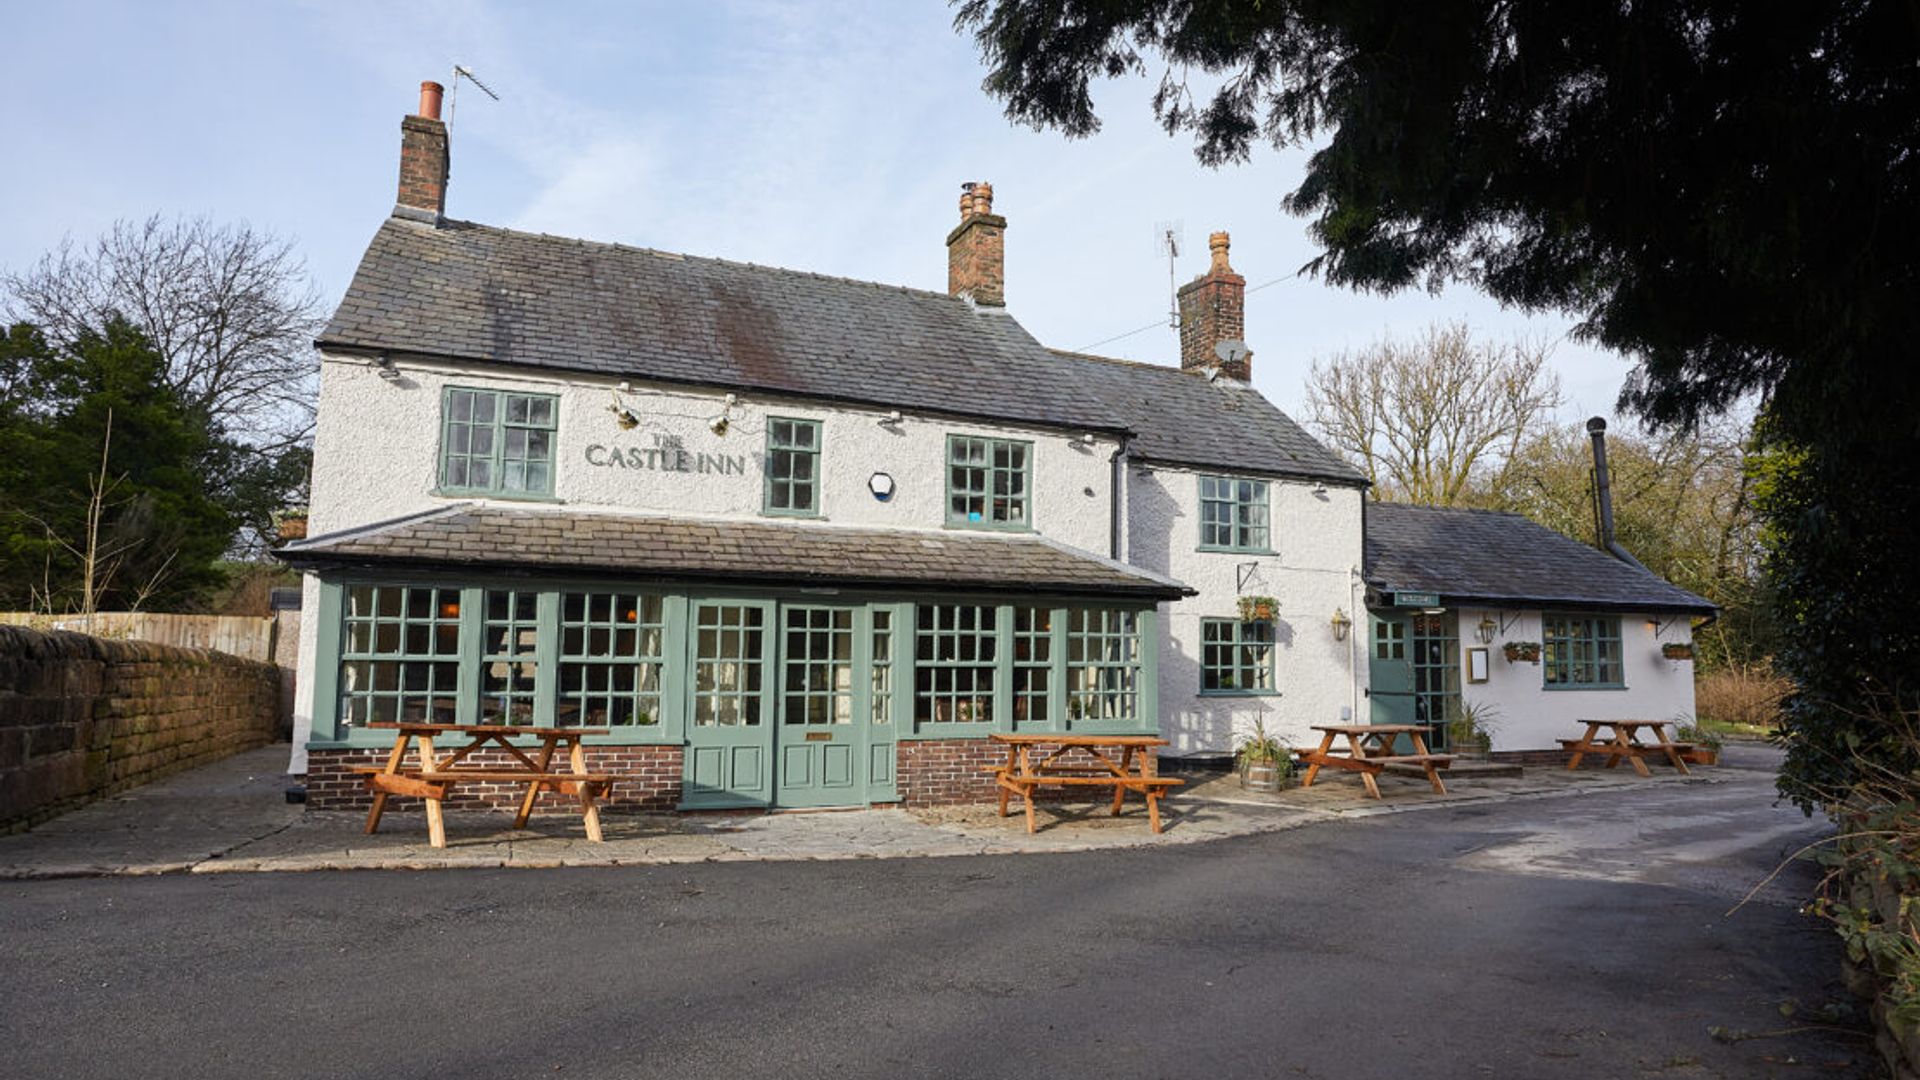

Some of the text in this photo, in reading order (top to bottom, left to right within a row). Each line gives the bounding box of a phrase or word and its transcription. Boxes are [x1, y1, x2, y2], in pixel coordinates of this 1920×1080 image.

[652, 432, 684, 449] THE
[585, 444, 745, 475] CASTLE INN
